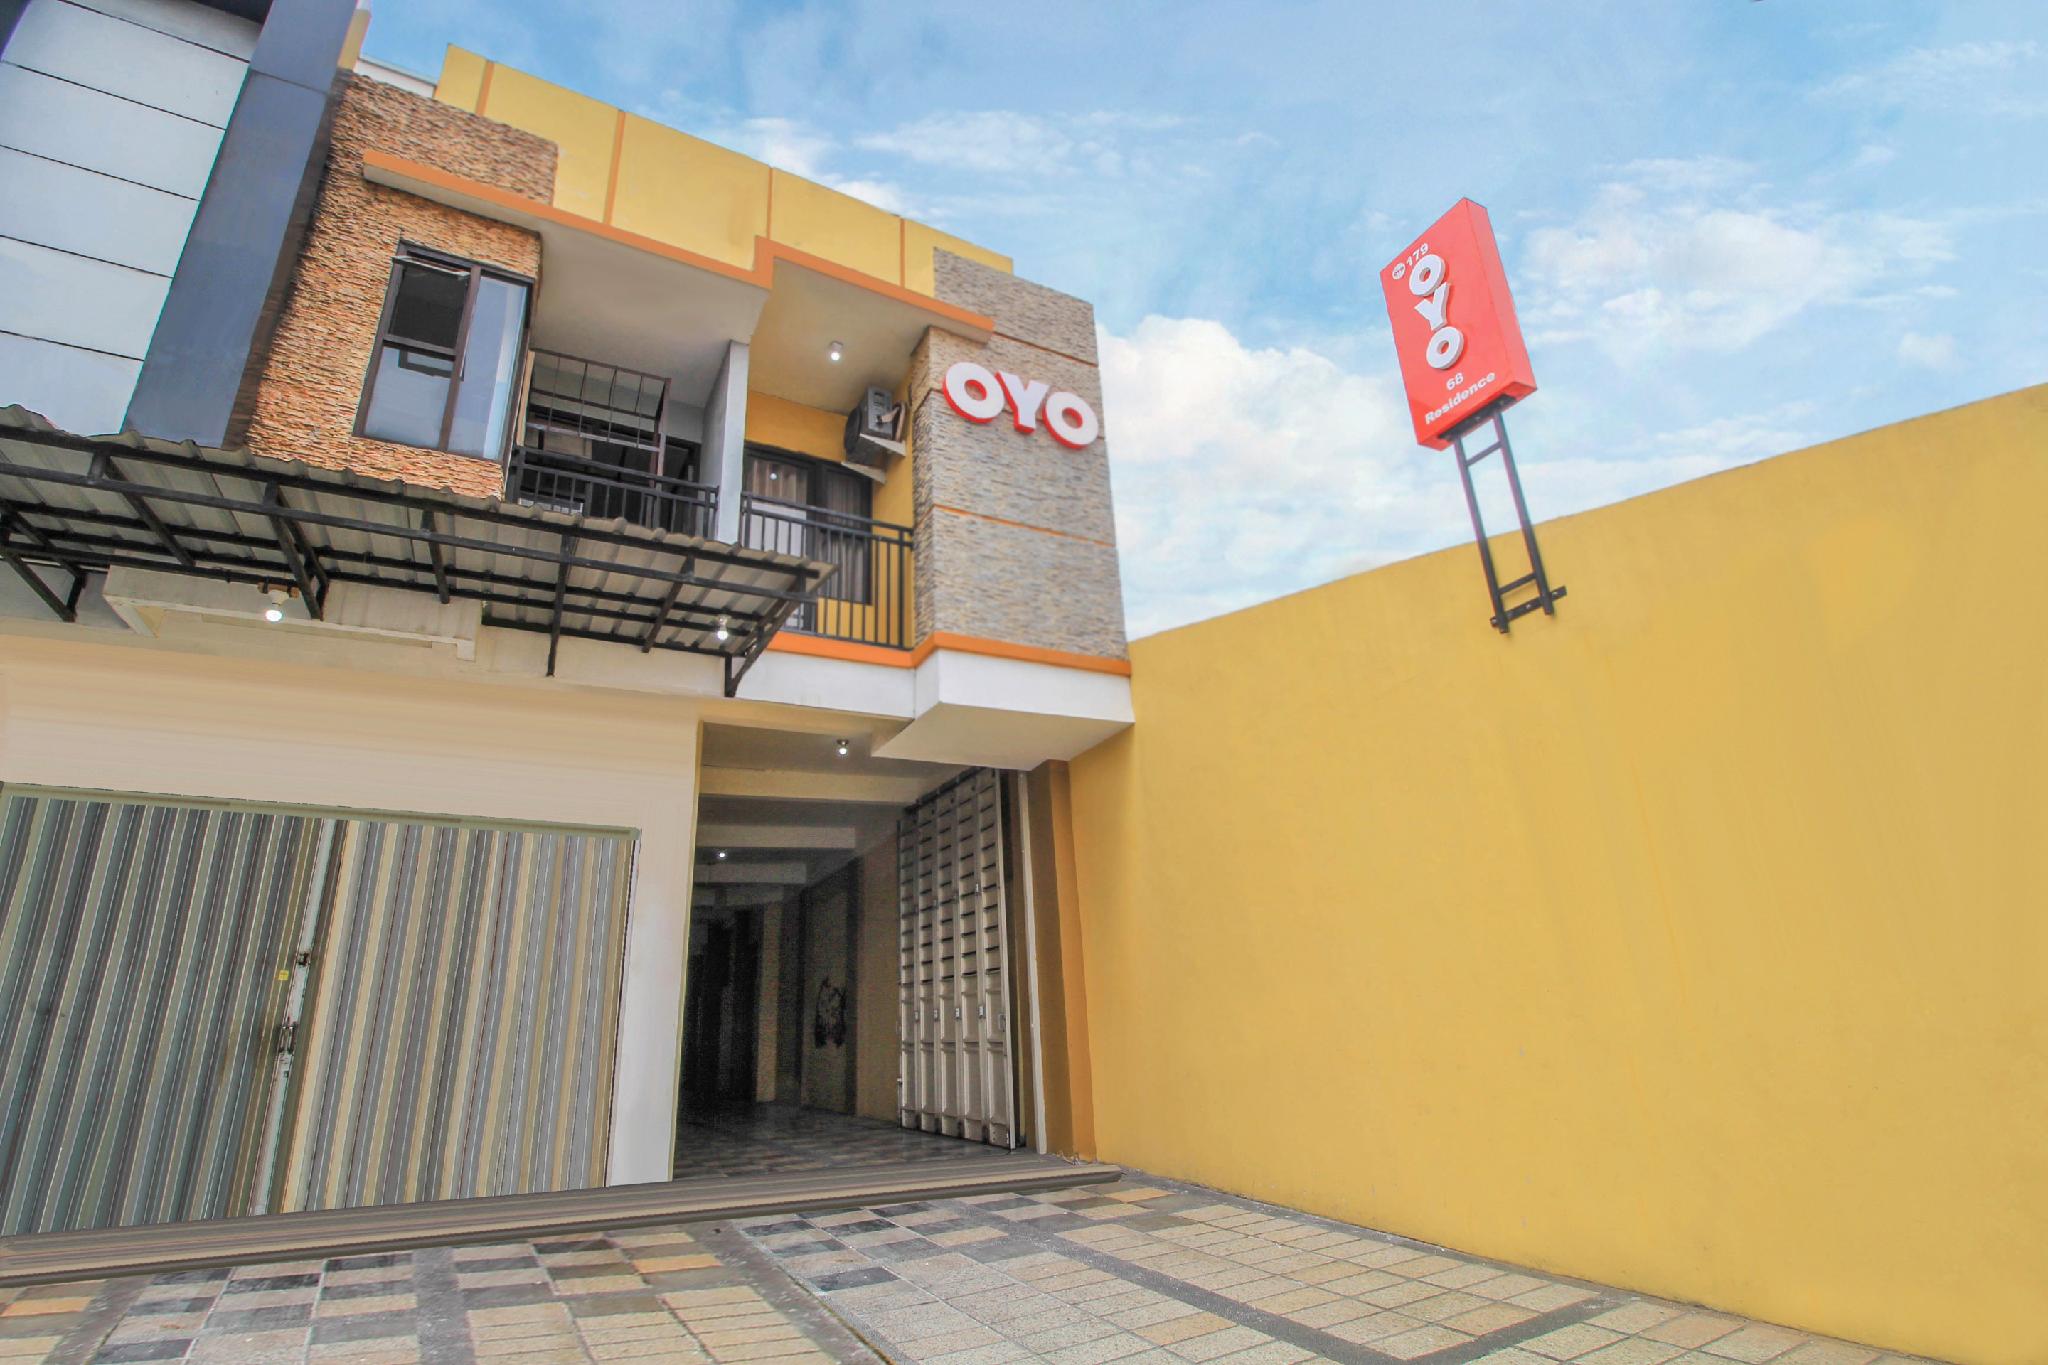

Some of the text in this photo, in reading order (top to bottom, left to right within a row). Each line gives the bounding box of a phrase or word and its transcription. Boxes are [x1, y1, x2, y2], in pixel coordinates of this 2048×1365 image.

[1406, 243, 1429, 266] 179
[1409, 254, 1464, 369] OYO
[943, 362, 1098, 449] OYO
[1425, 372, 1496, 424] Residence
